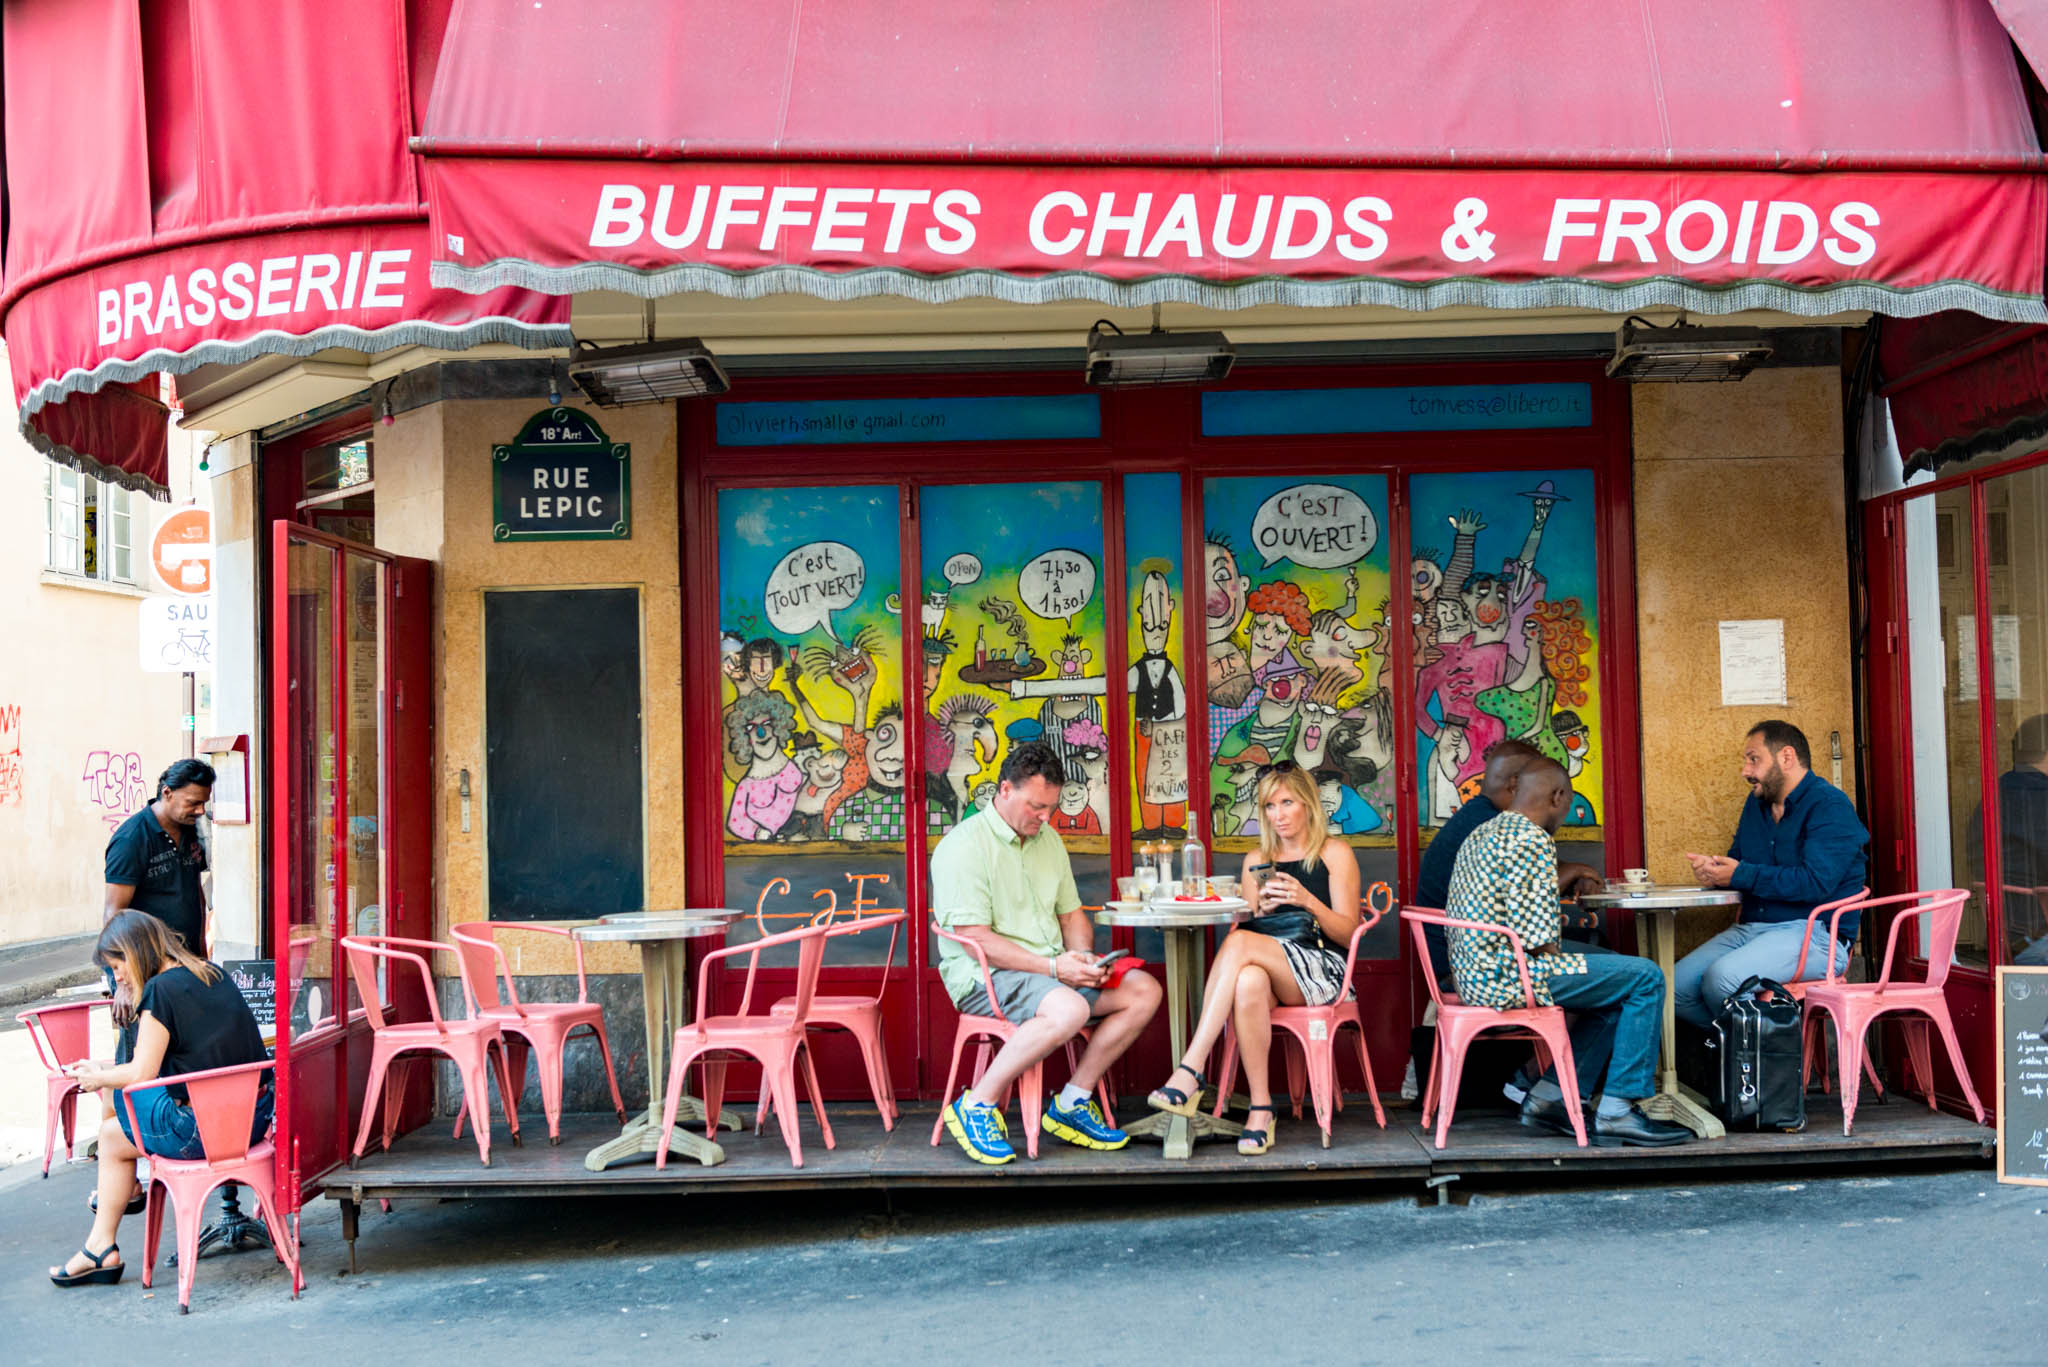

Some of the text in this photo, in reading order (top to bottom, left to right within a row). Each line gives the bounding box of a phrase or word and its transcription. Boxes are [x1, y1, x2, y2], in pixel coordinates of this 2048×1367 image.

[589, 184, 1881, 266] BUFFETS CHAUDS & FROIDS
[98, 249, 411, 347] BRASSERIE
[533, 467, 589, 489] RUE
[520, 496, 603, 518] LEPIC
[1040, 560, 1081, 581] 7h30
[167, 604, 208, 620] SAU
[1160, 759, 1173, 776] 2
